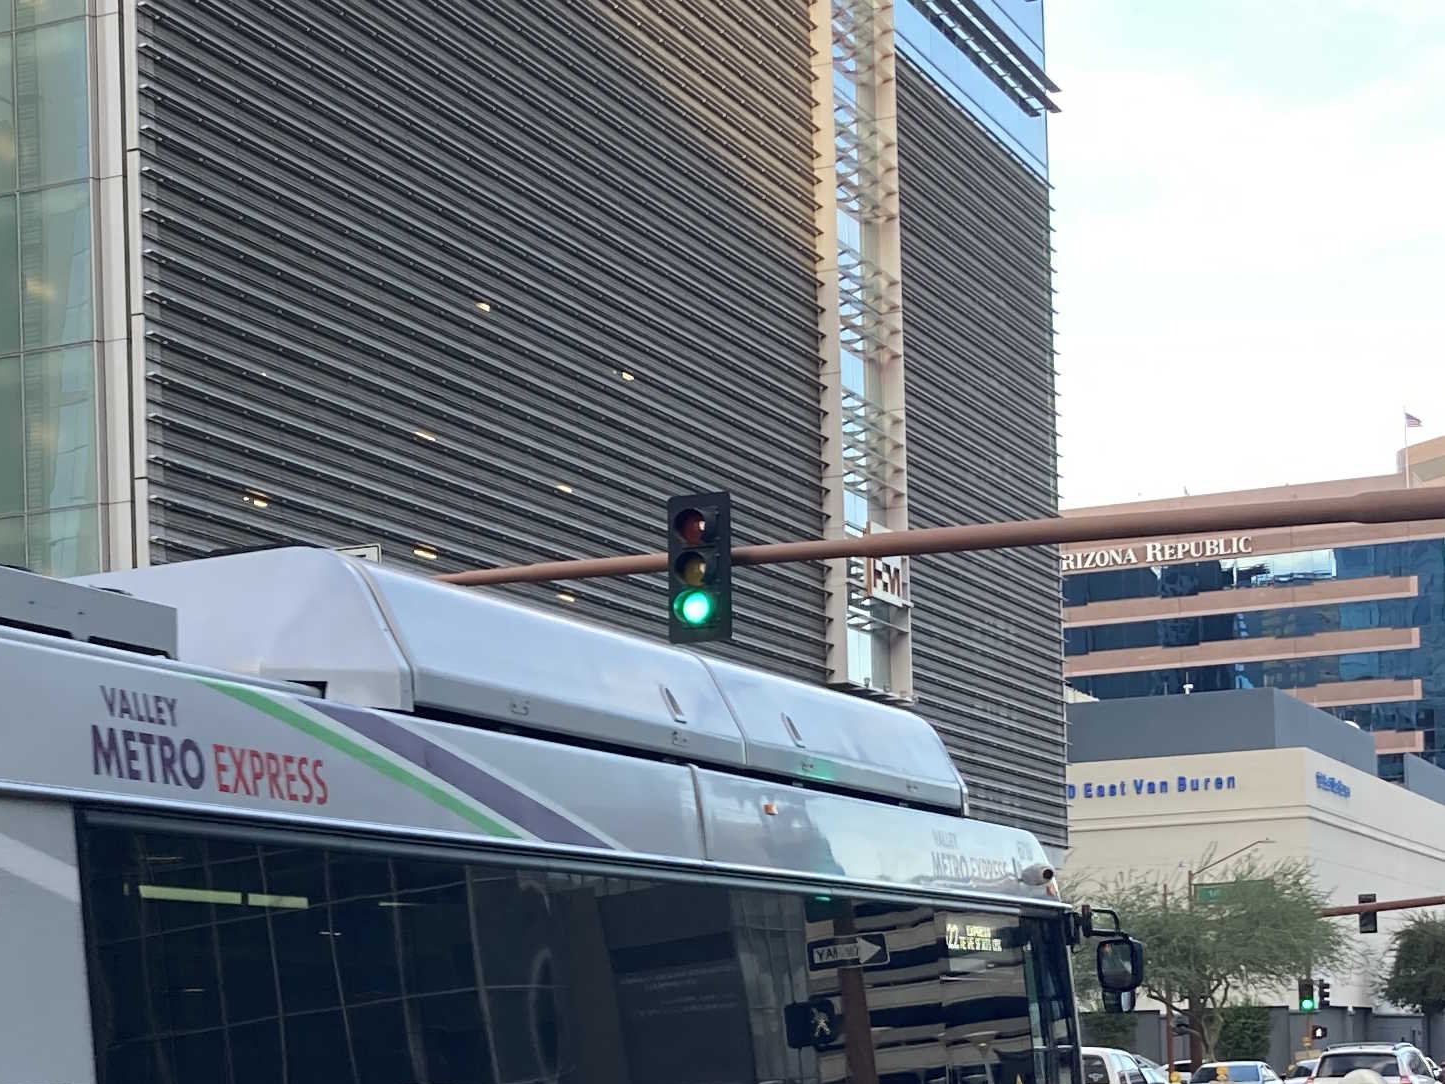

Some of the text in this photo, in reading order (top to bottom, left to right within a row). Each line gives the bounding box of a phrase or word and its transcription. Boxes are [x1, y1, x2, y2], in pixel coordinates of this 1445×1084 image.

[1146, 536, 1253, 562] REPUBLIC
[99, 685, 179, 726] VALLEY
[90, 725, 328, 806] METRO EXPRESS
[1083, 781, 1126, 799] East
[1133, 779, 1168, 795] Van
[1178, 776, 1236, 793] Buren
